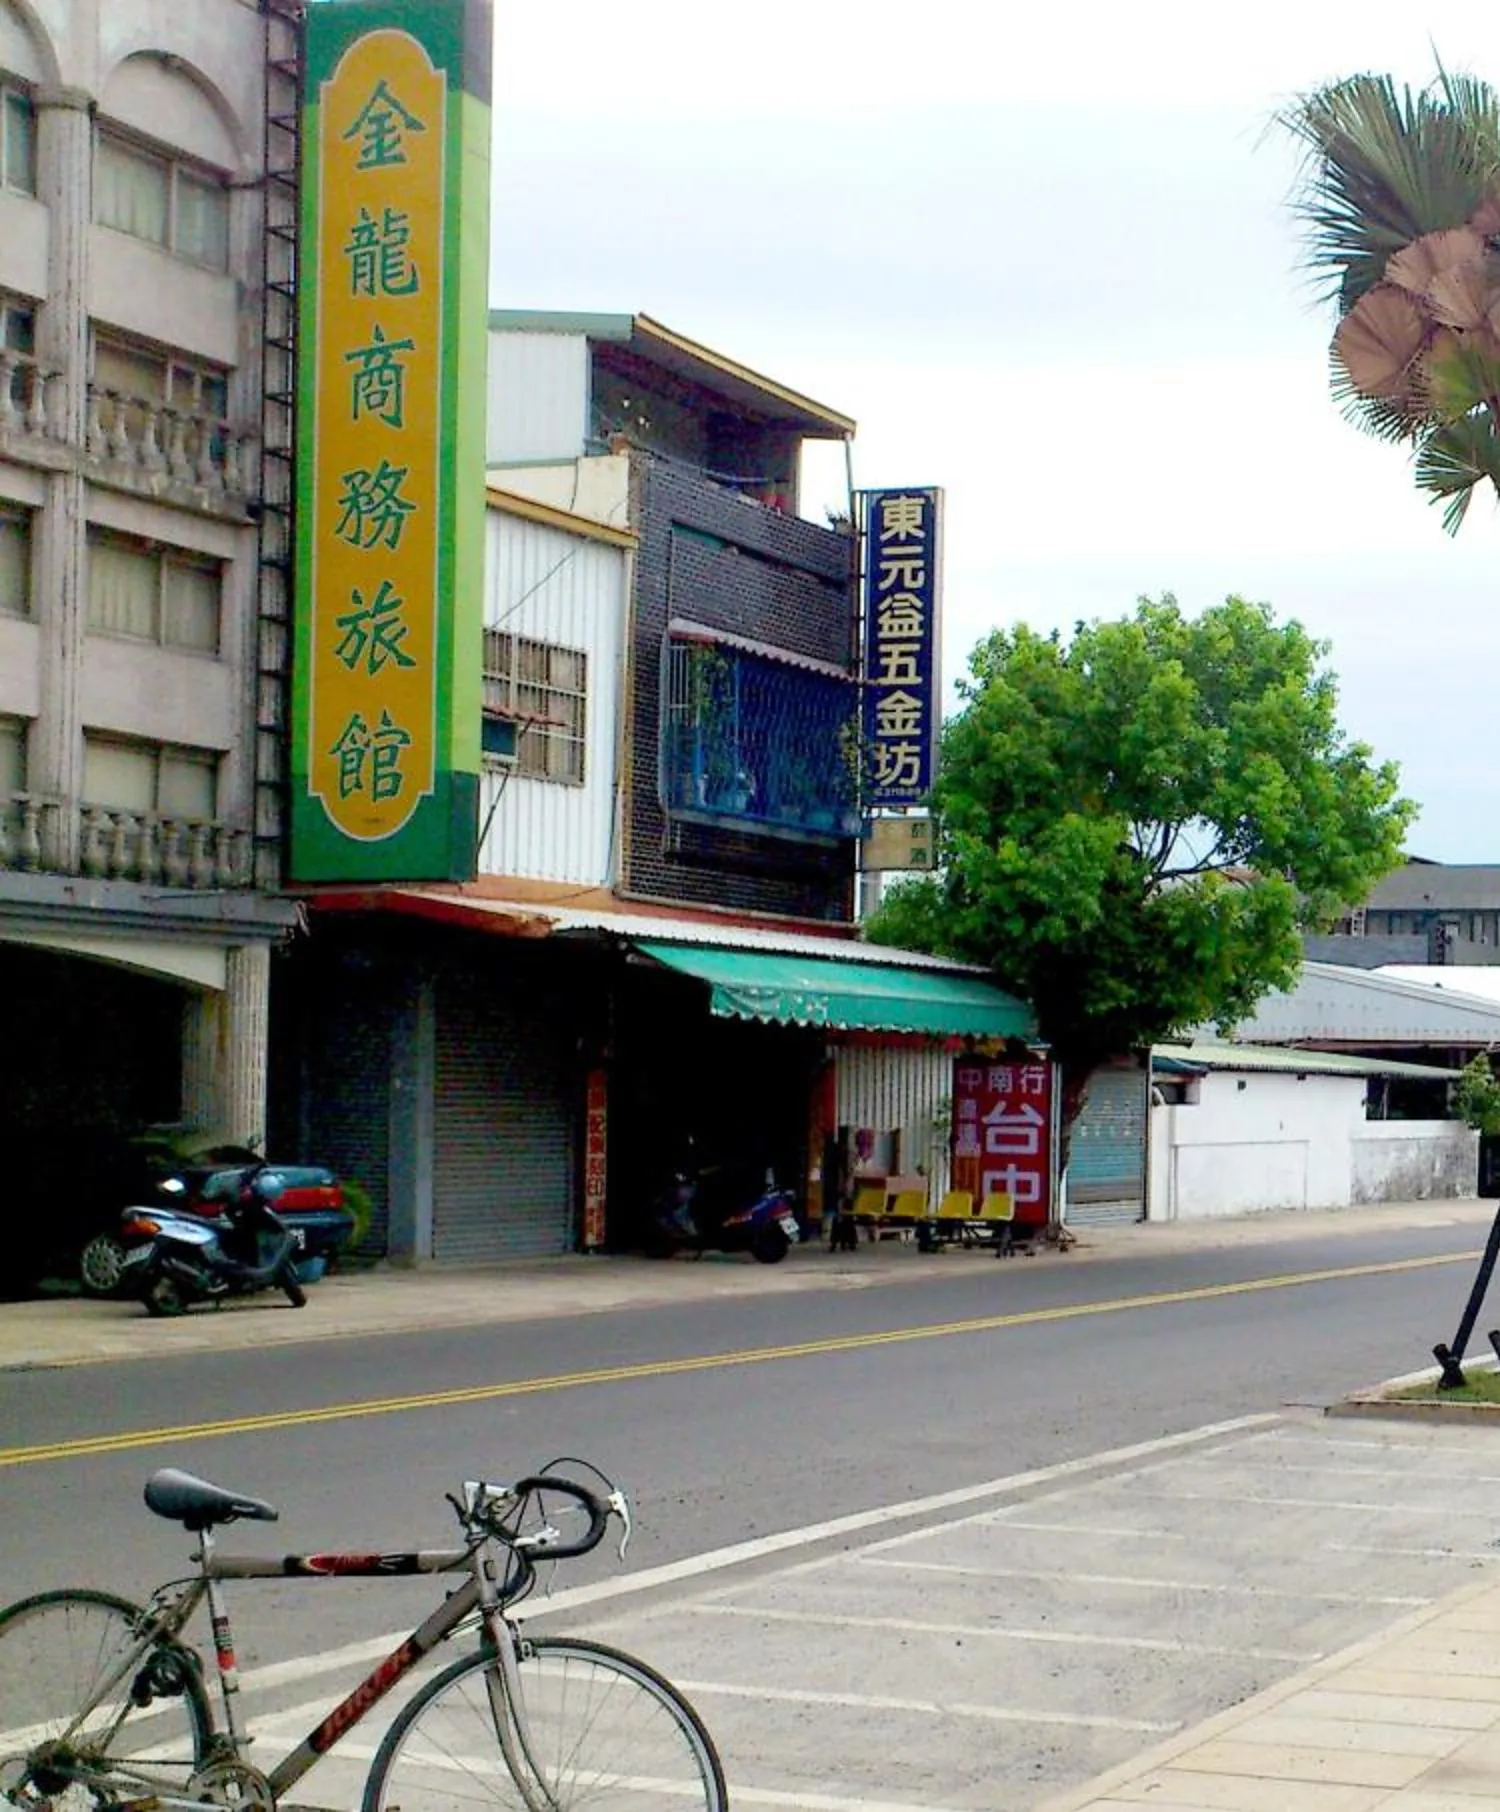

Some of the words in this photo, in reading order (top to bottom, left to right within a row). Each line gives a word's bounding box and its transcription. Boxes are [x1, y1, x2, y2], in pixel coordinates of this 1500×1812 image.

[330, 78, 426, 803] 金龍商務旅館
[875, 495, 926, 787] 東元益五金坊
[958, 1065, 1047, 1095] 中南行
[982, 1100, 1045, 1204] 台中
